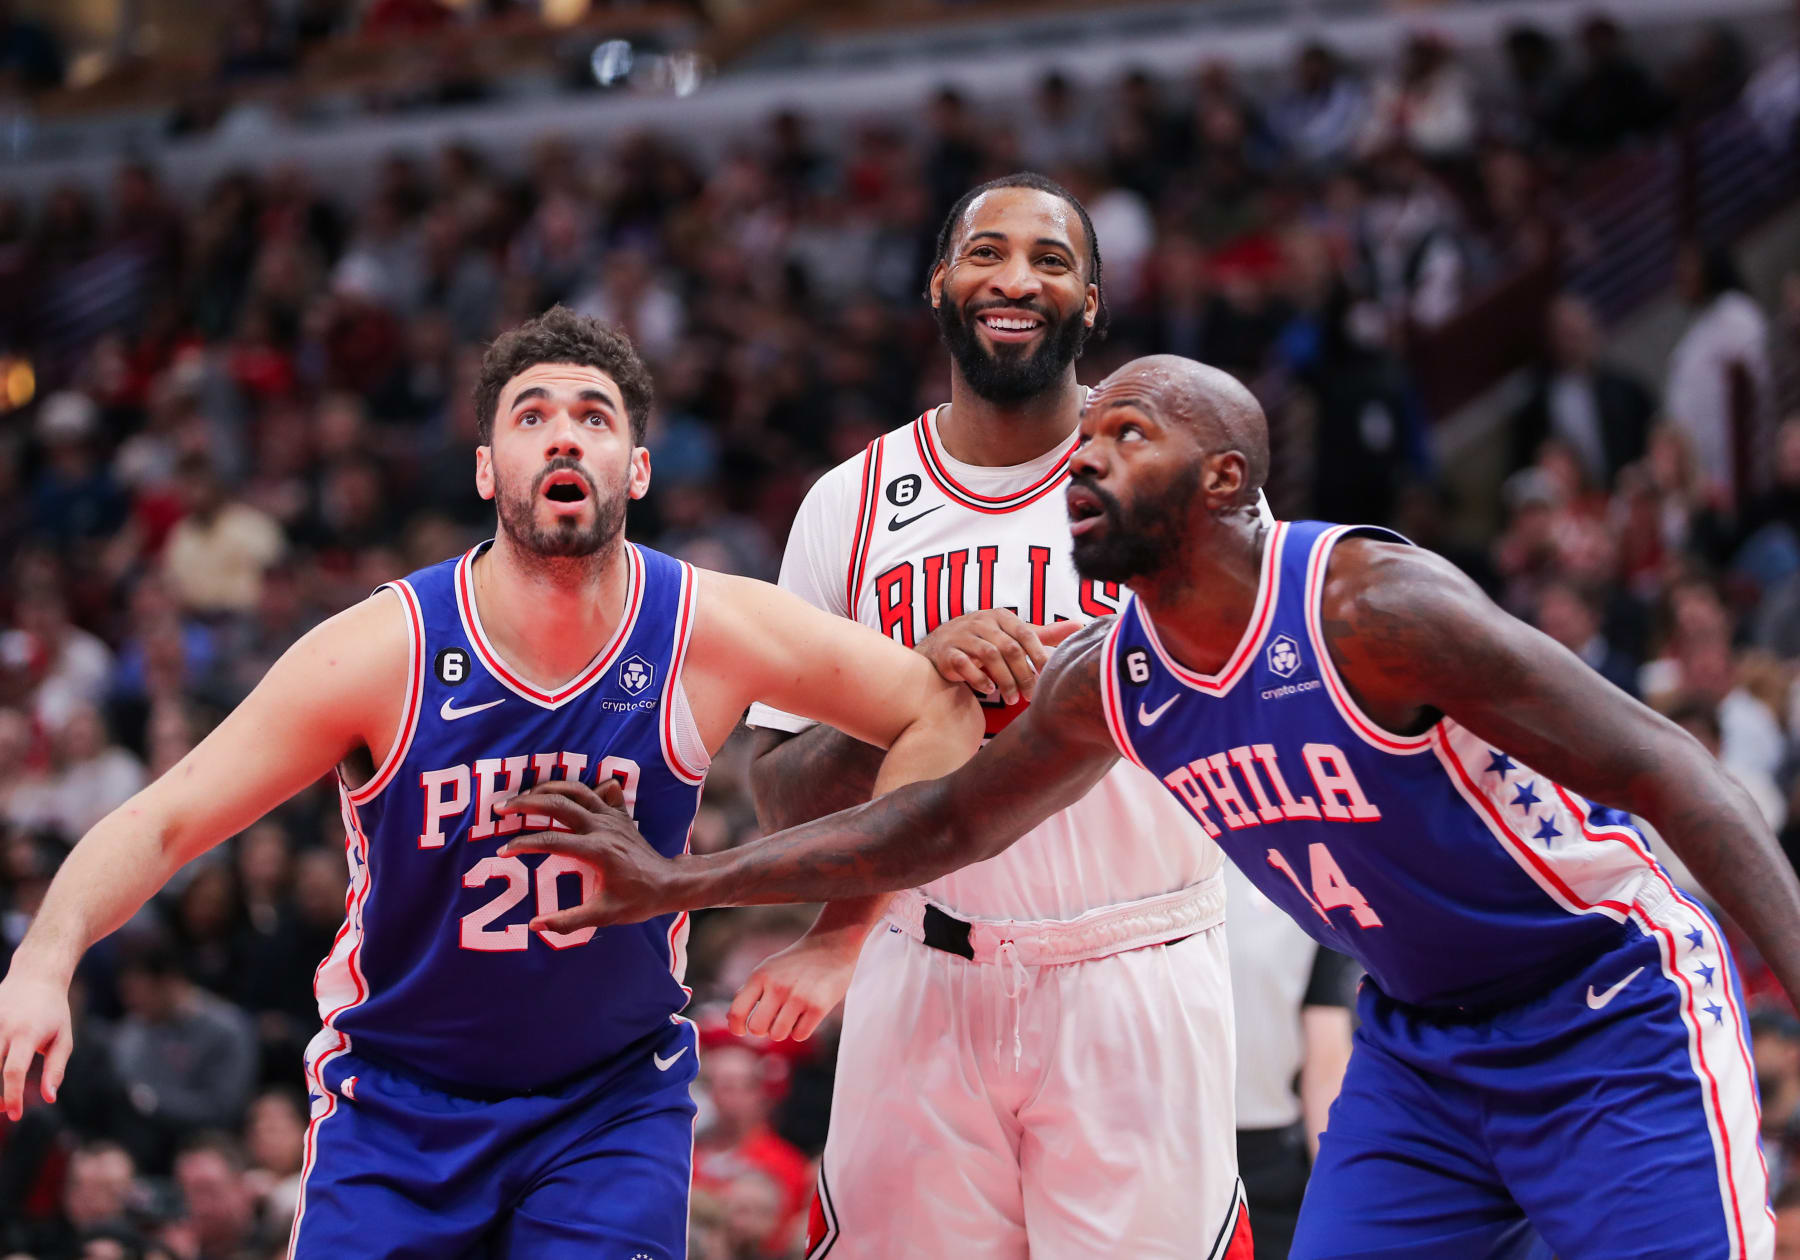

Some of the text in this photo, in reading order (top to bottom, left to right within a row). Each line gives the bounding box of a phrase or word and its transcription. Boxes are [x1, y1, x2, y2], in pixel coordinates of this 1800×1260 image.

[894, 477, 914, 504] 6
[442, 653, 463, 681] 6
[1126, 651, 1149, 683] 6
[1261, 680, 1320, 700] crypto.com
[602, 700, 657, 712] cryptoco
[1163, 743, 1382, 838] PHILA
[1266, 842, 1384, 930] 14
[458, 853, 604, 952] 20
